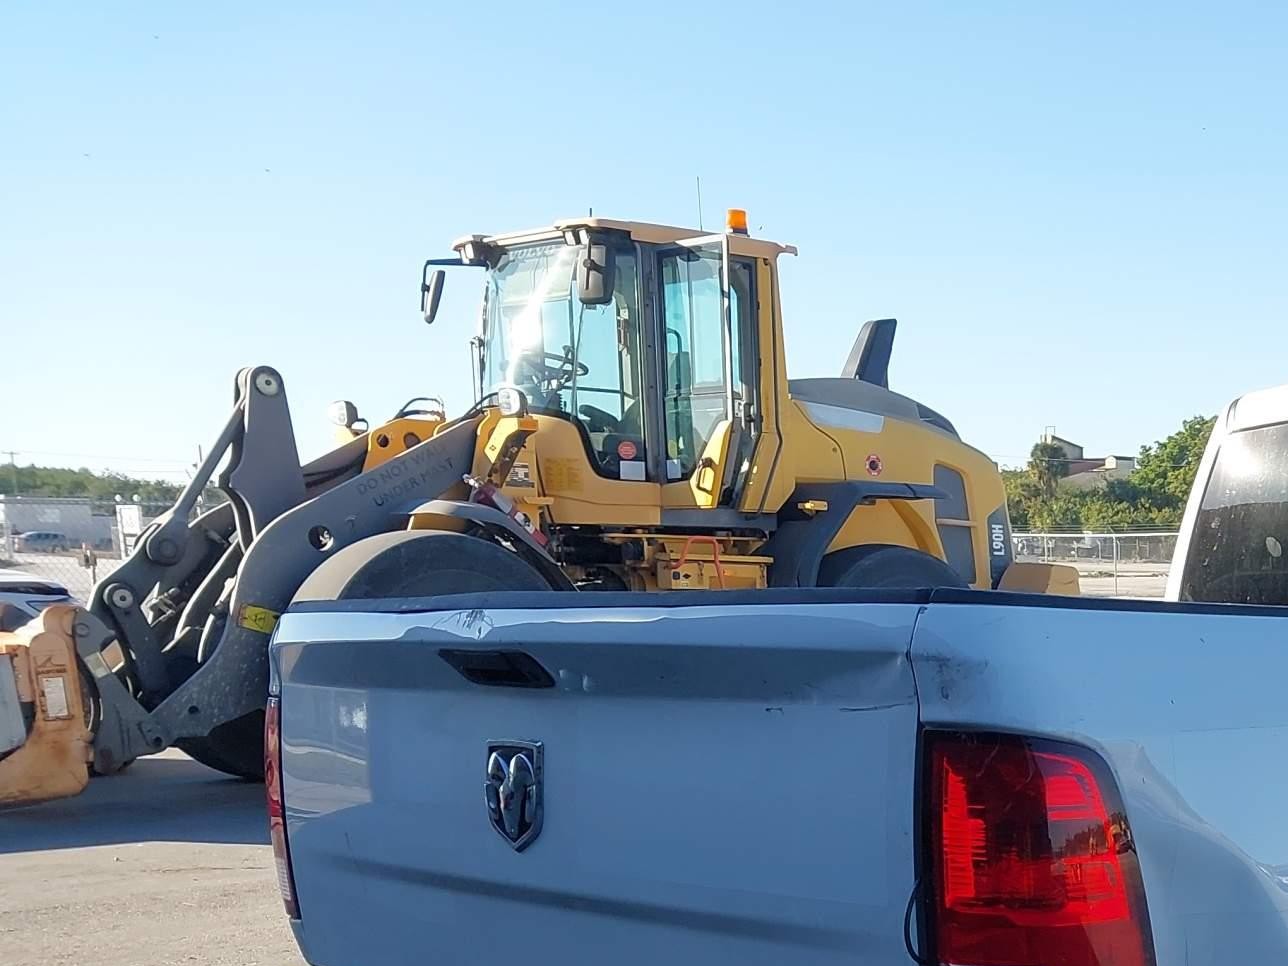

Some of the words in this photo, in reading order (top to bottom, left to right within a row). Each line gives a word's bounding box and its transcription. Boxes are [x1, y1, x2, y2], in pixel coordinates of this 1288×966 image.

[357, 477, 379, 496] DO
[380, 460, 409, 482] NOT
[412, 442, 446, 465] WAL
[373, 476, 421, 507] UNDER
[991, 523, 1005, 556] L90H
